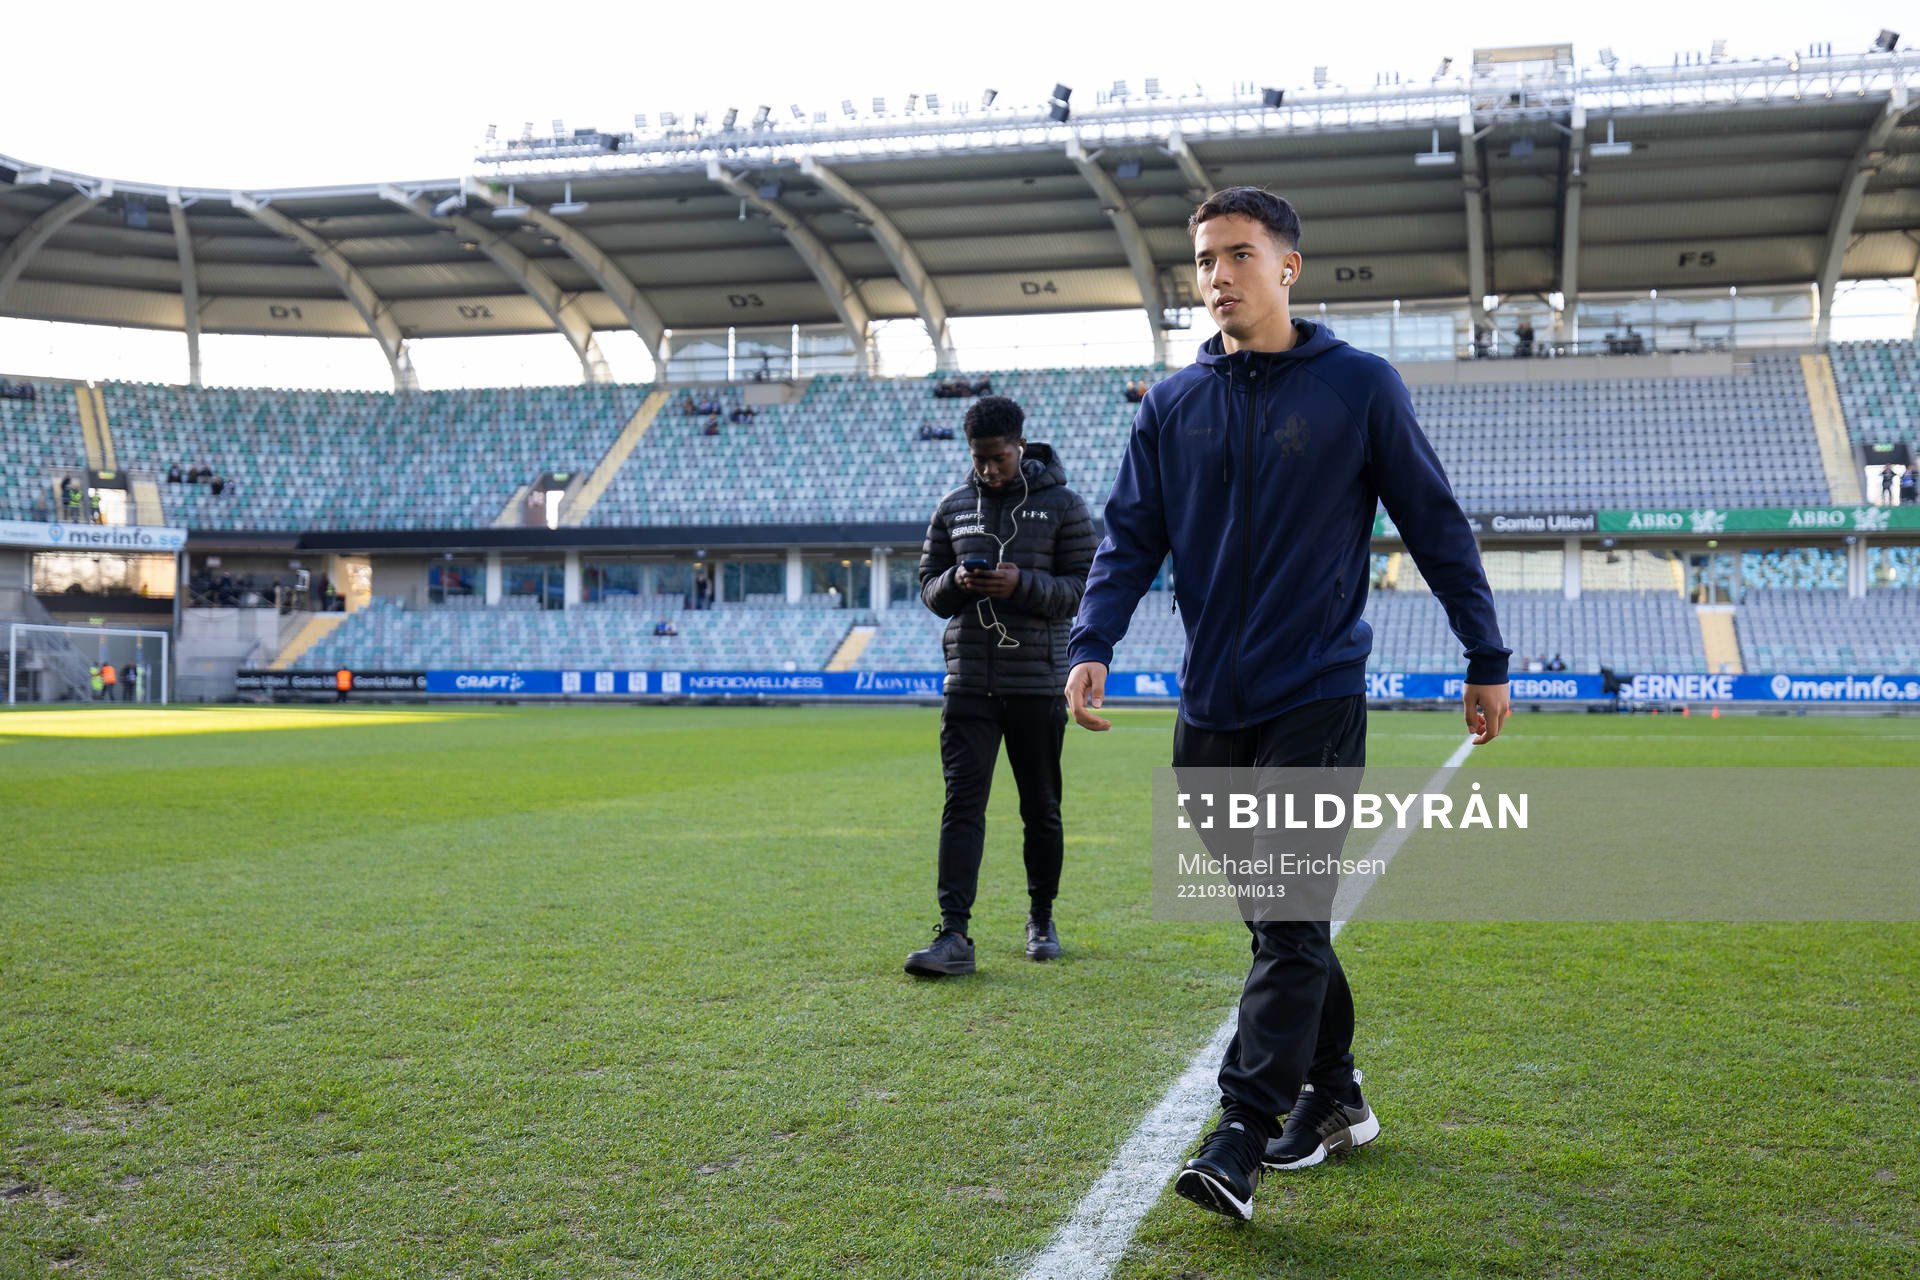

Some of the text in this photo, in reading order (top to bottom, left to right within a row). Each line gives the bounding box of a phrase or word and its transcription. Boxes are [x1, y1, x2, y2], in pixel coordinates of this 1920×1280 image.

[1679, 251, 1716, 266] F5
[1336, 267, 1373, 280] D5
[1021, 281, 1058, 295] D4
[728, 294, 763, 307] D3
[270, 305, 302, 318] D1
[459, 305, 493, 318] D2
[1492, 515, 1546, 532] Gamla
[1548, 514, 1594, 532] Ullevi
[1628, 511, 1684, 531] ÅBRO
[1788, 509, 1846, 528] ÅBRO
[952, 524, 985, 537] SERNEKE
[456, 675, 509, 689] CRAFT
[1444, 679, 1464, 697] IF
[1792, 675, 1920, 700] merinfo.s
